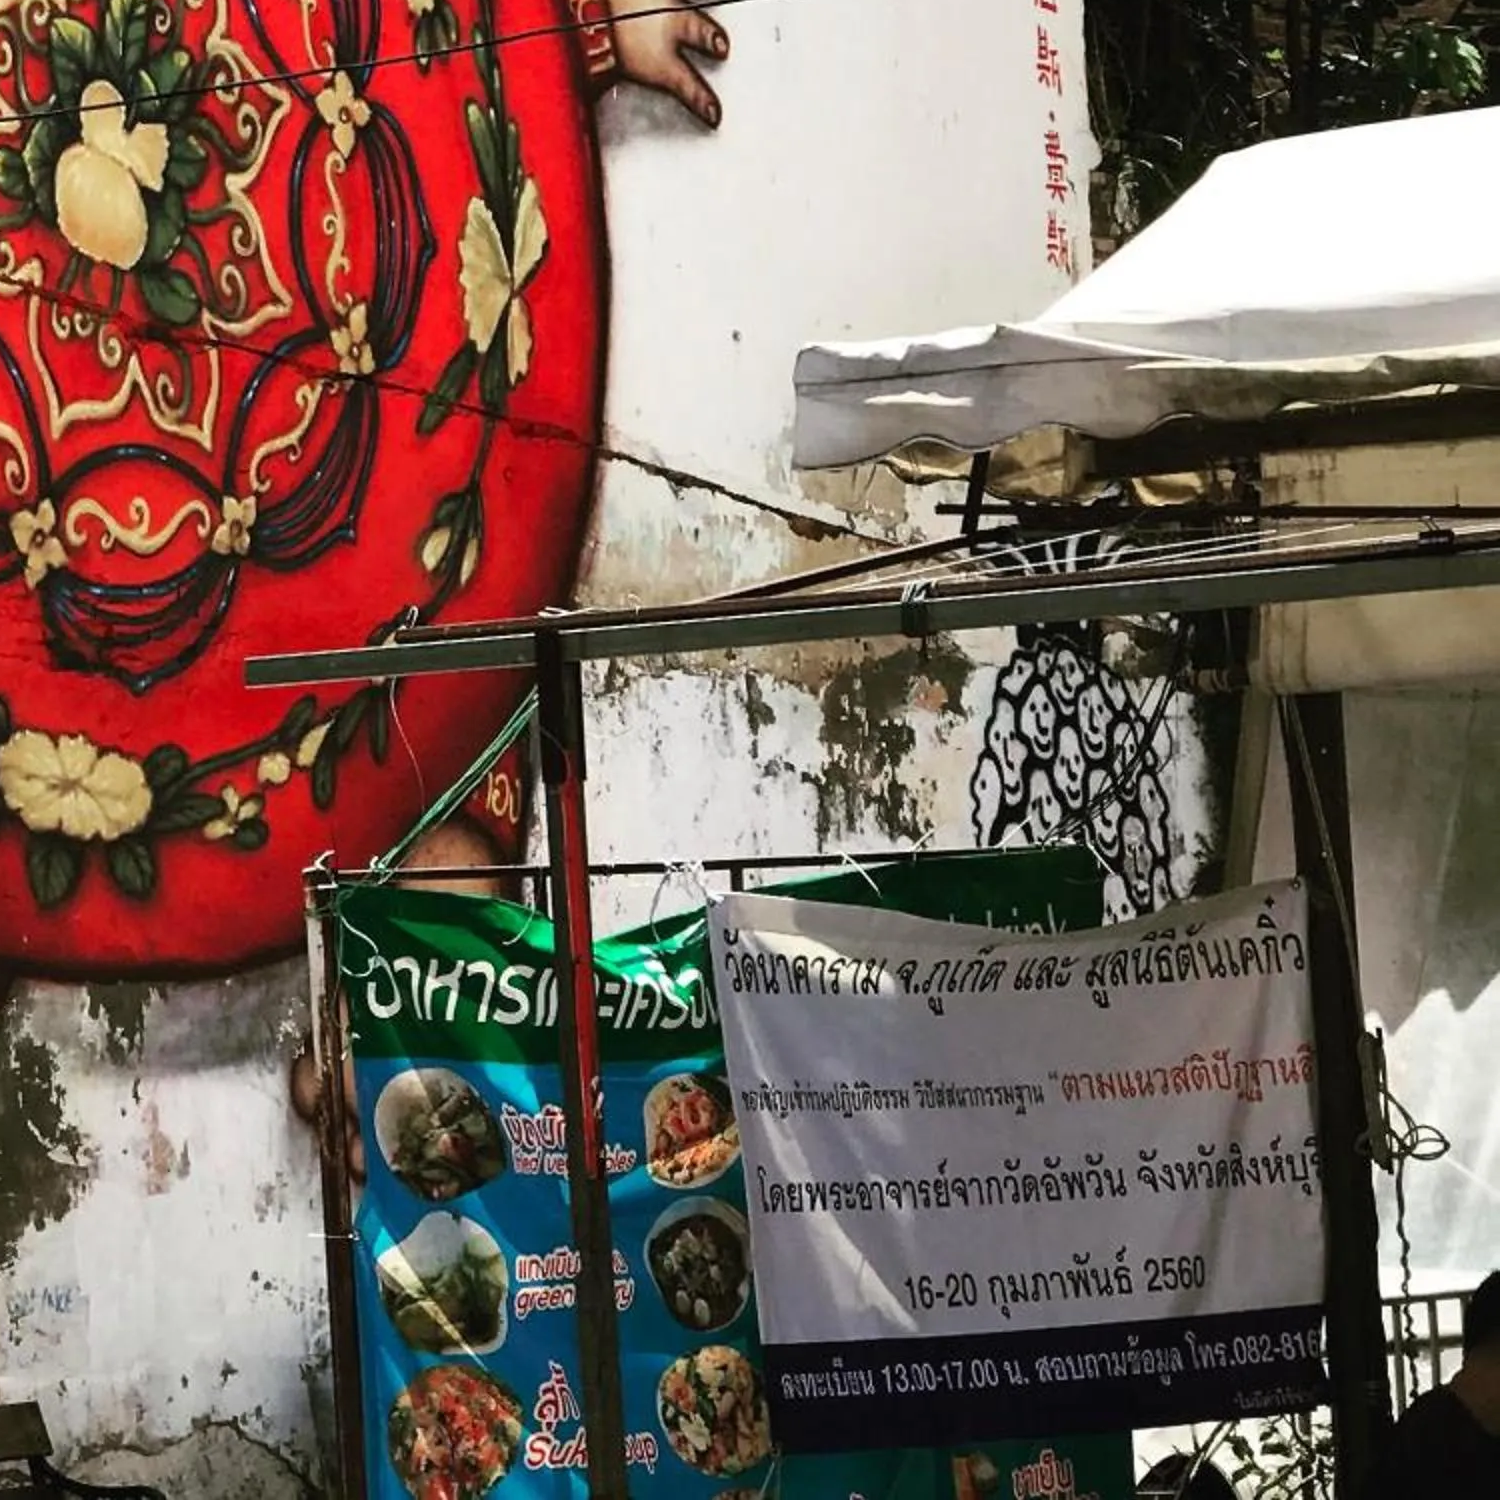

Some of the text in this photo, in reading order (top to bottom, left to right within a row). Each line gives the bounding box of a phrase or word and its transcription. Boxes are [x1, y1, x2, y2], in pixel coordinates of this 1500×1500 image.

[1013, 955, 1080, 991] และ
[515, 1283, 577, 1320] green
[905, 1245, 1206, 1319] 16-20 กุมภาพันธ์ 2560
[881, 1357, 1000, 1394] 13.00-17.00
[1003, 1359, 1031, 1387] น.
[1185, 1330, 1322, 1369] โทร.082-816
